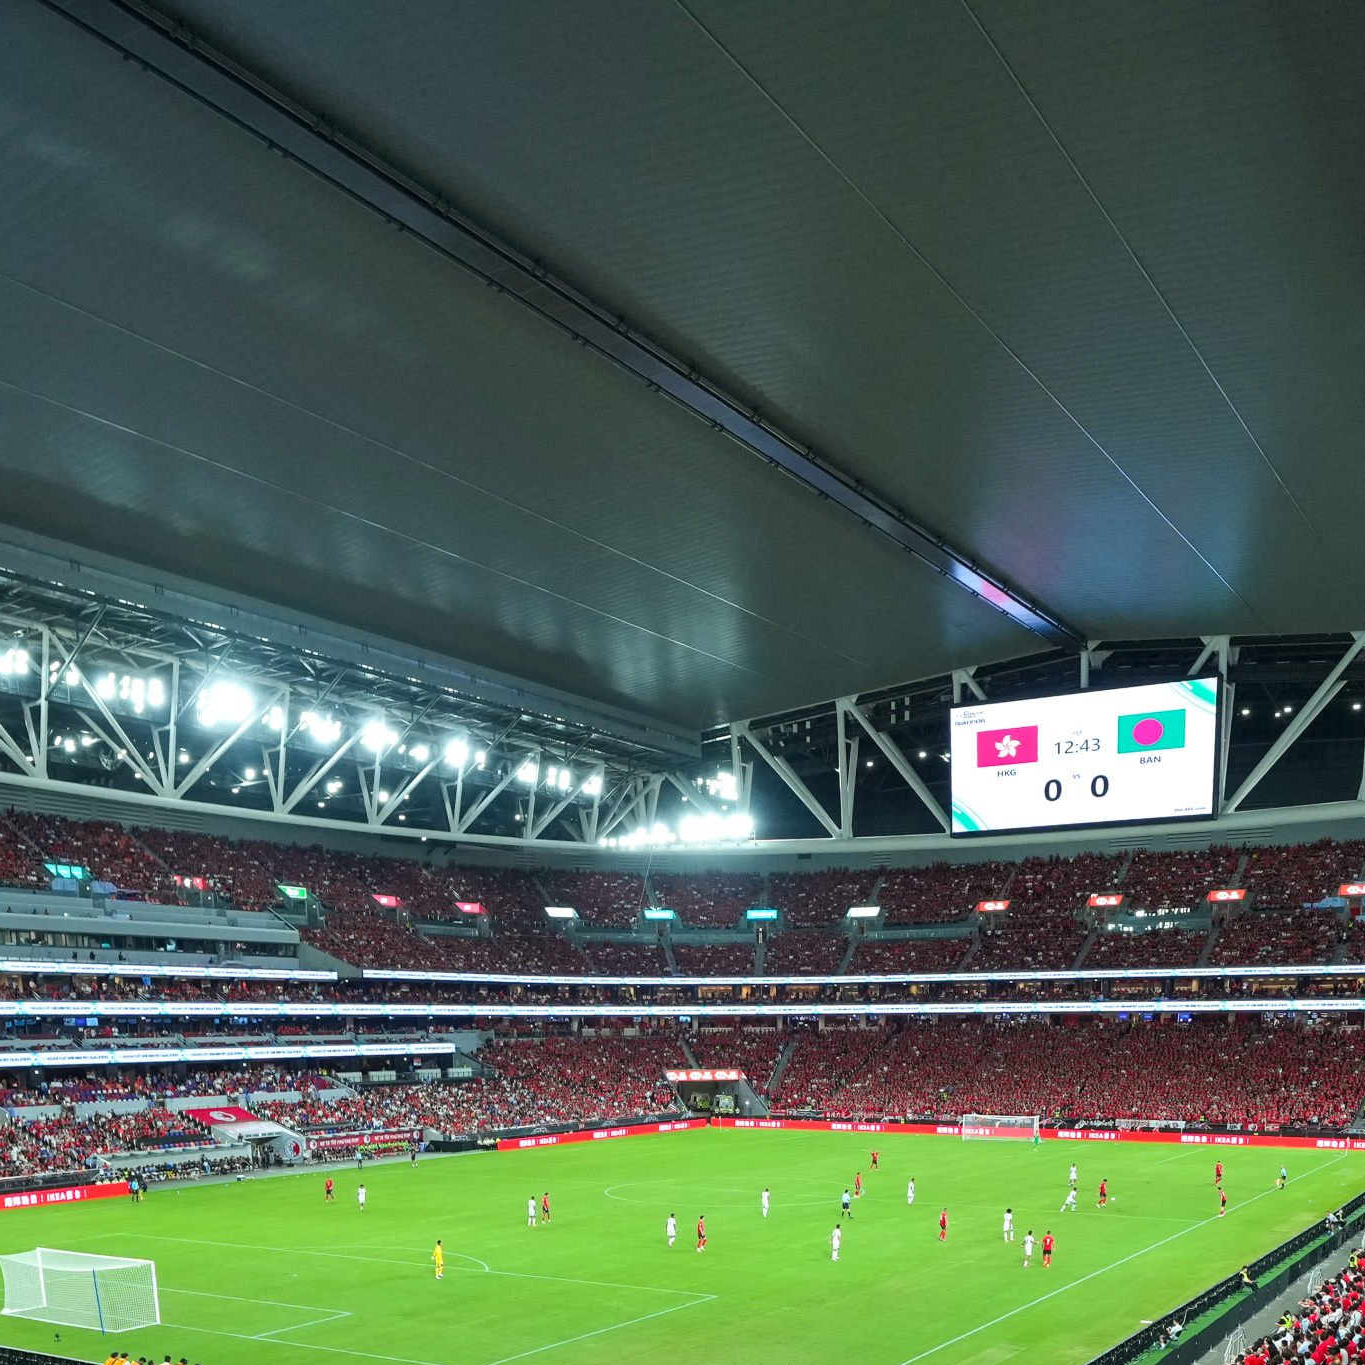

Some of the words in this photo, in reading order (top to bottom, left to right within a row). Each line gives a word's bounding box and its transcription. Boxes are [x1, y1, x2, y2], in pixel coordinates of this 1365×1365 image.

[1054, 738, 1101, 755] 12:43
[1140, 756, 1162, 765] BAN
[997, 769, 1017, 777] HKG
[1044, 779, 1062, 801] 0
[1091, 775, 1109, 797] 0
